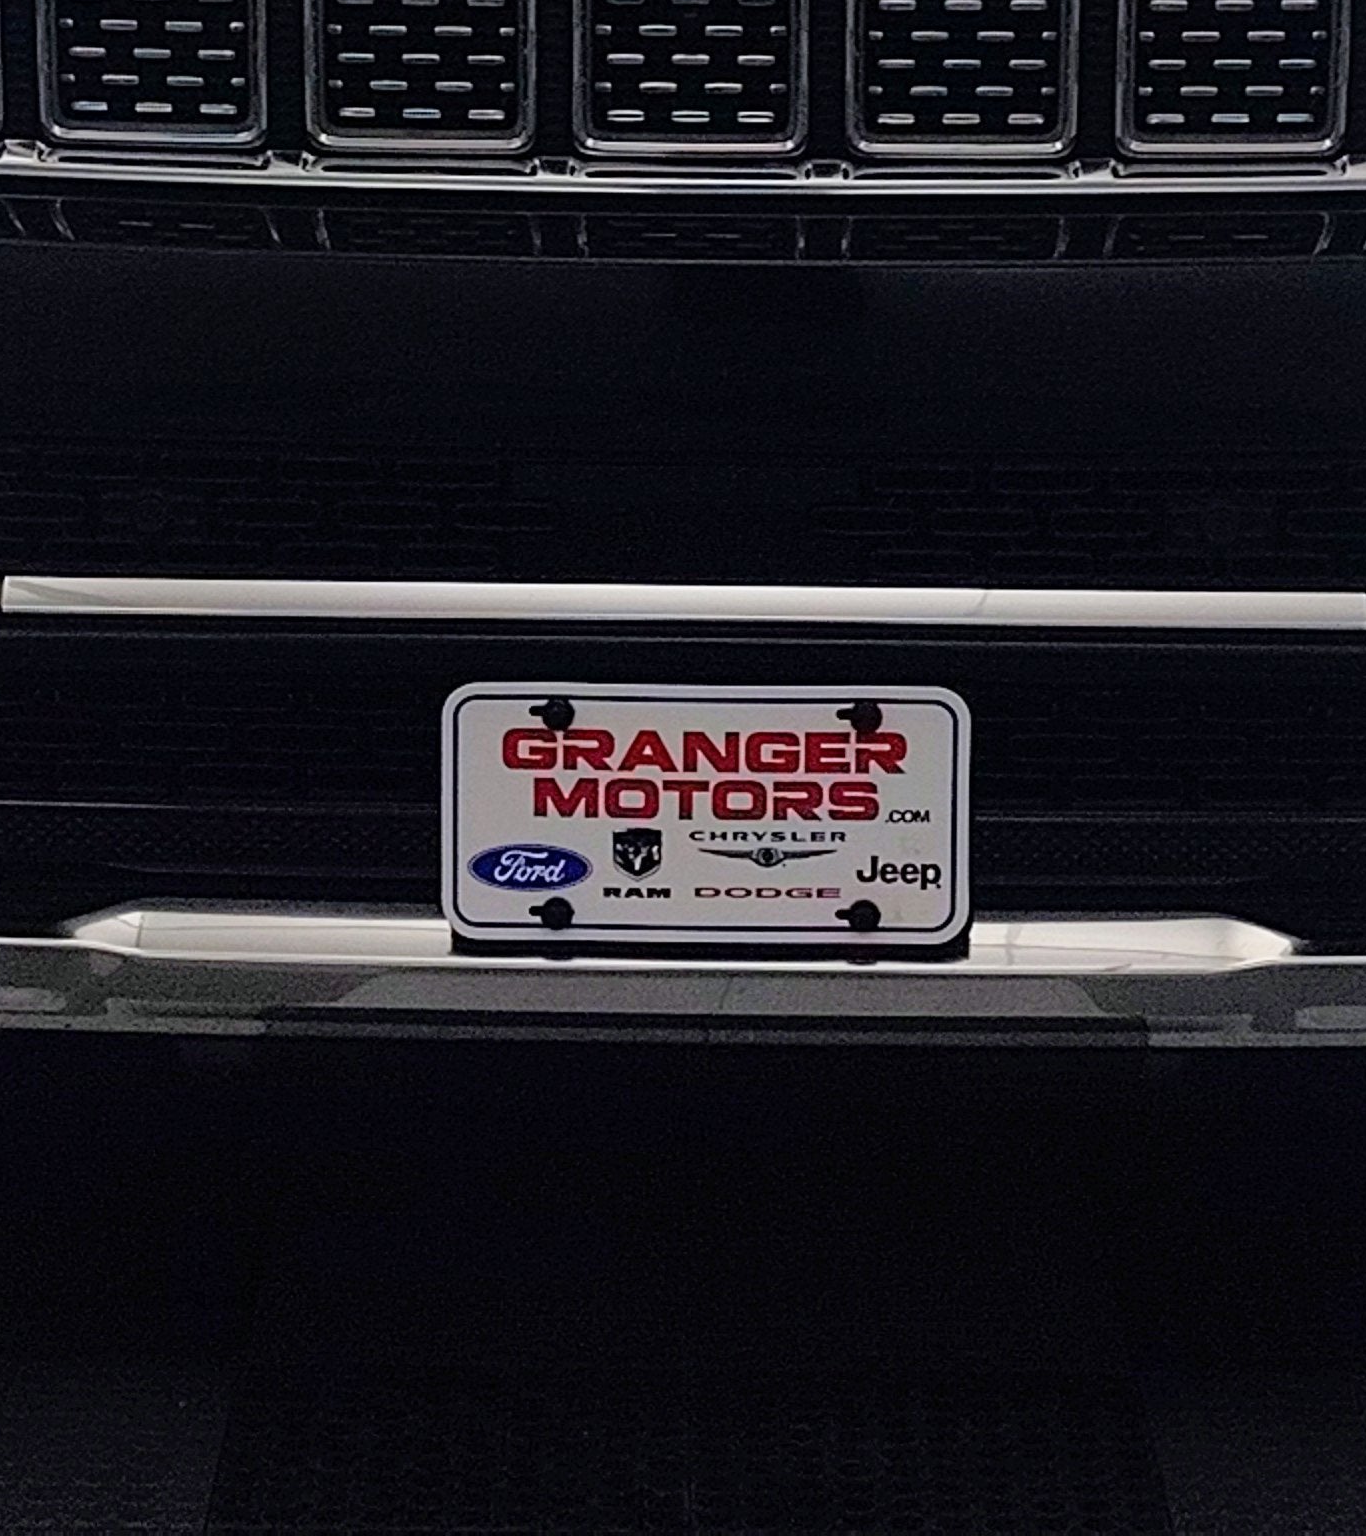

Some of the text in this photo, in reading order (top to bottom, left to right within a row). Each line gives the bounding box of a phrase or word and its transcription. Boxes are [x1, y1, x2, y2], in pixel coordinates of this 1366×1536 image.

[502, 728, 908, 775] GRANGER
[533, 777, 931, 824] MOTORS .COM
[688, 830, 848, 843] CHRYSLER
[493, 849, 567, 883] Ford
[855, 855, 942, 891] Jeep
[602, 886, 672, 899] RAM
[693, 886, 843, 899] DODGE
